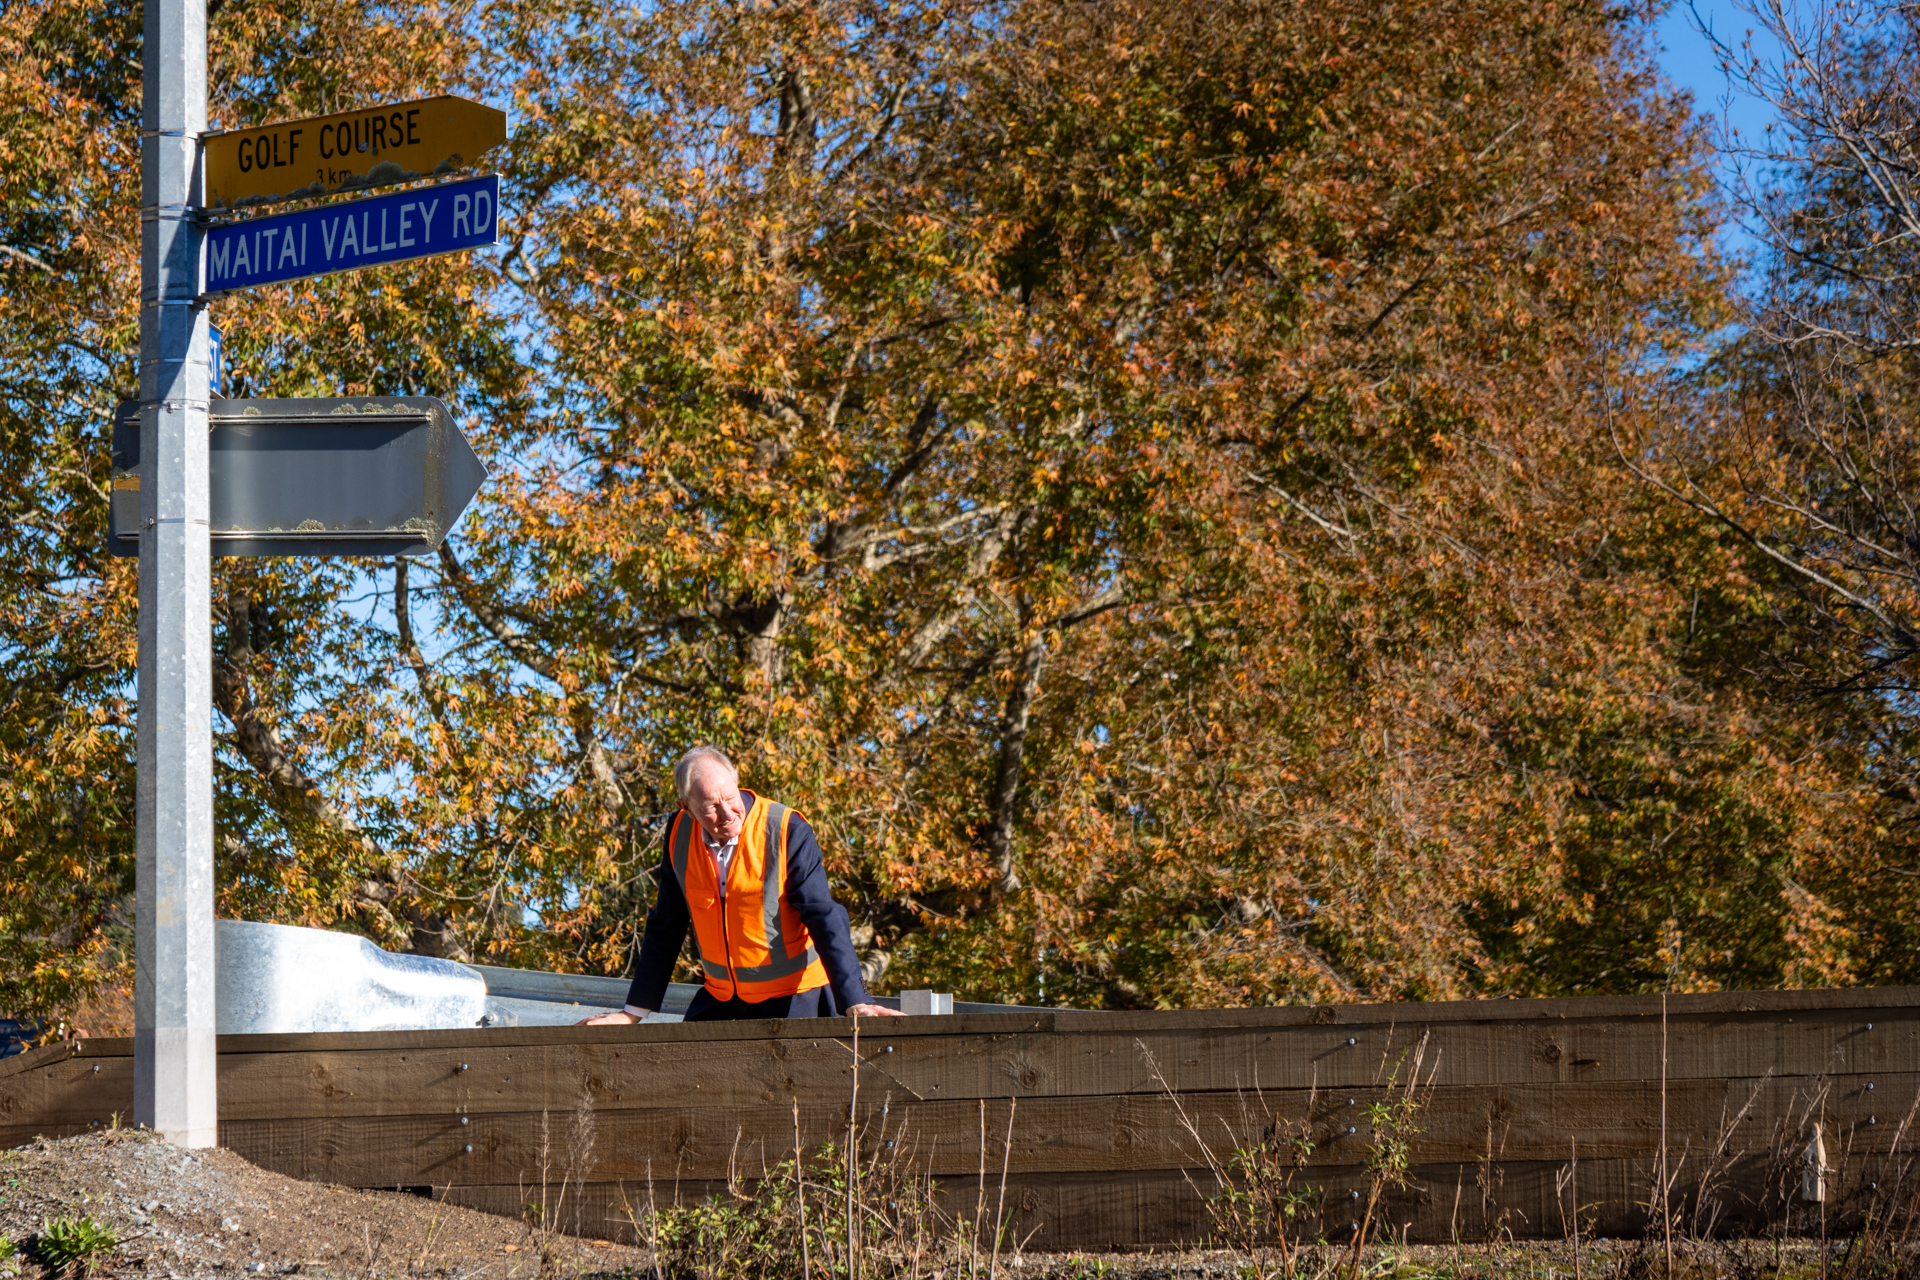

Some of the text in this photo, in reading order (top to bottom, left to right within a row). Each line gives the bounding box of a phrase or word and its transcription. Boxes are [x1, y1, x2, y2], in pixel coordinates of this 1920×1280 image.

[238, 109, 421, 173] GOLF COURSE
[316, 168, 324, 185] 3
[210, 190, 492, 282] MAITAI VALLEY RD
